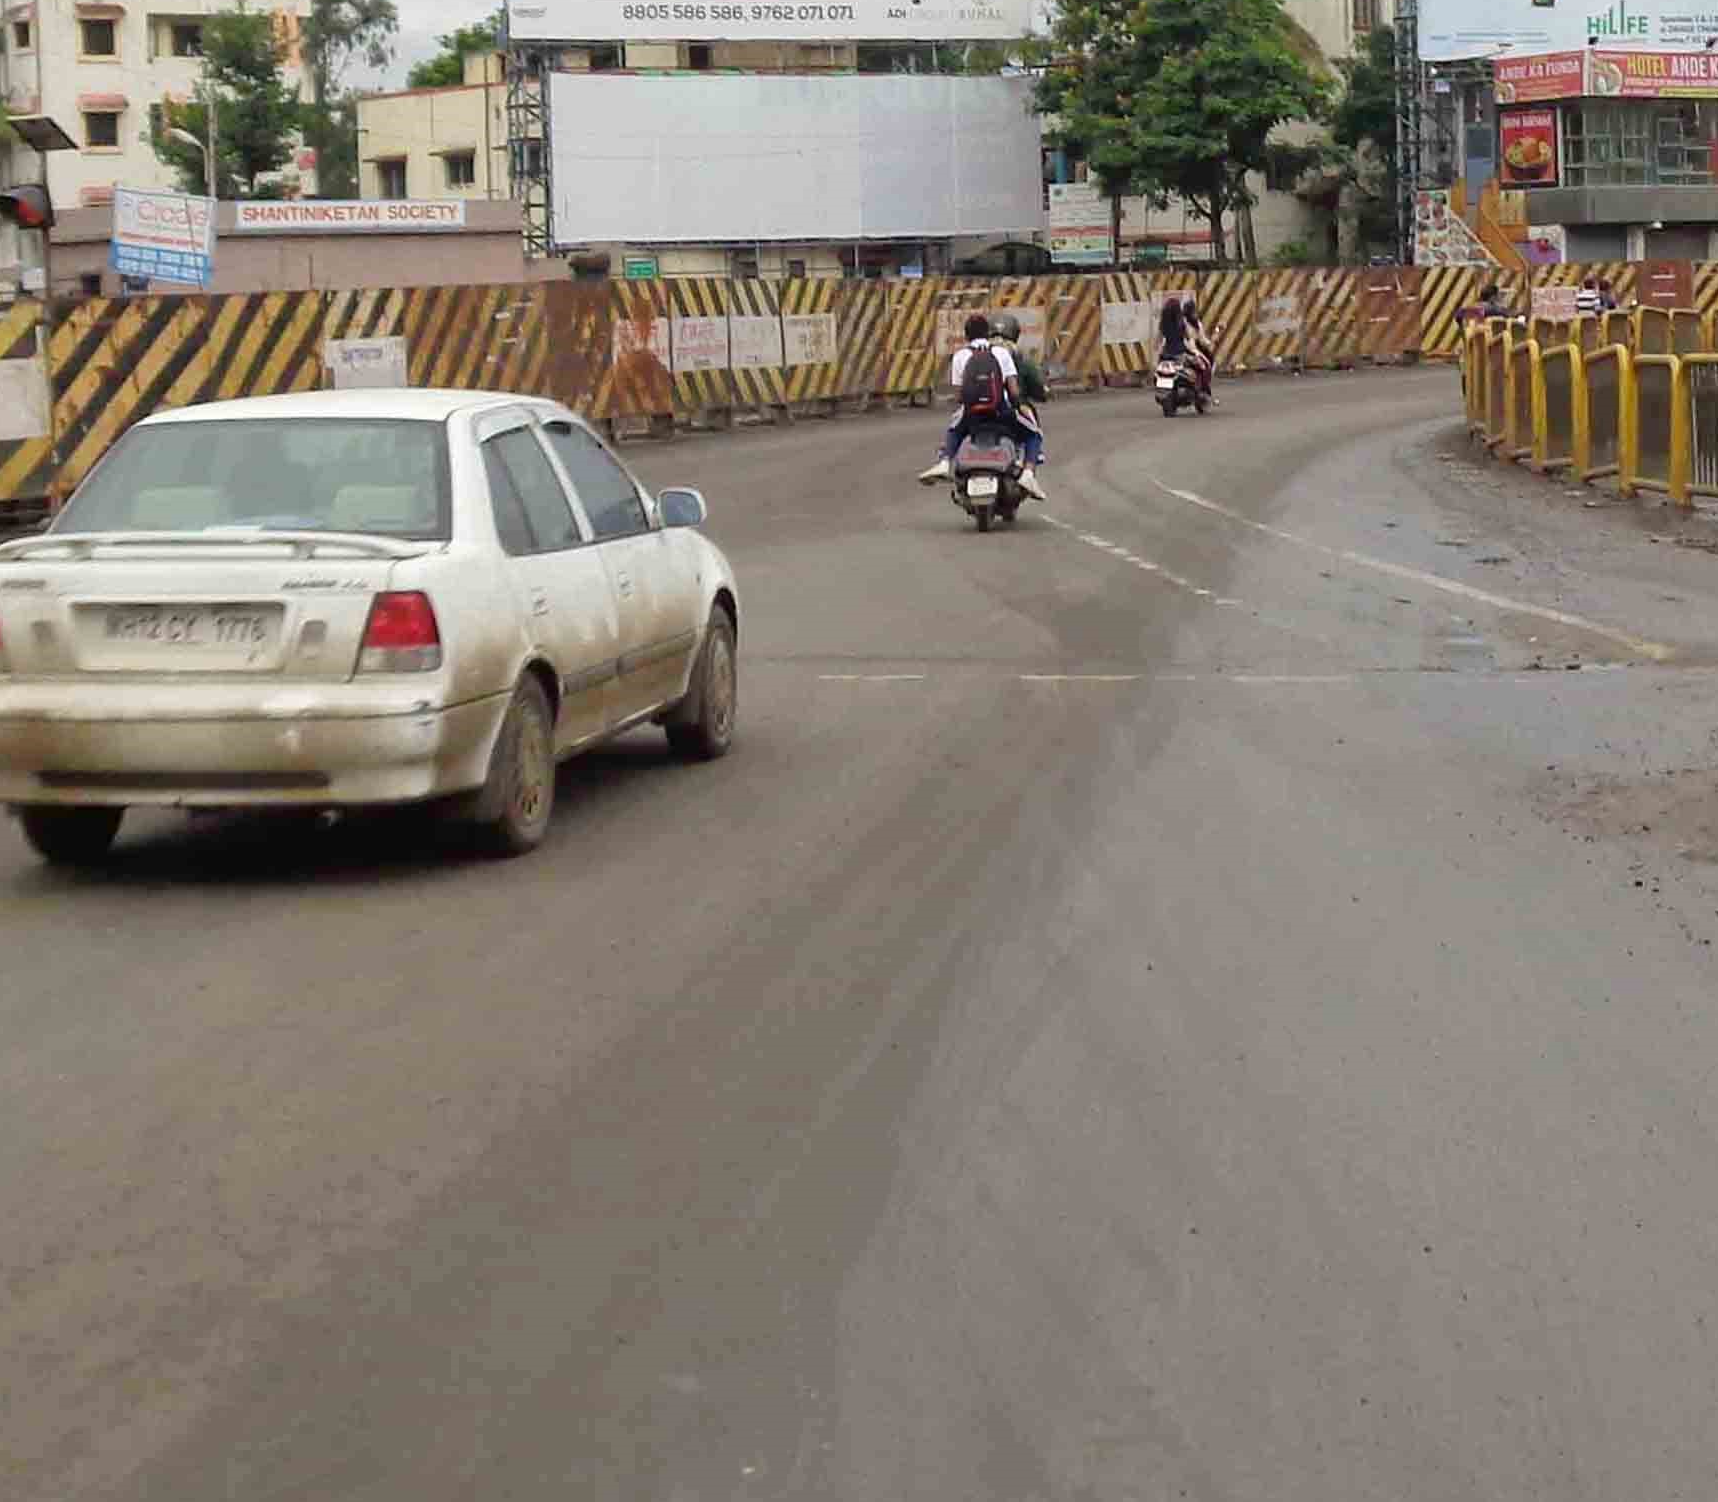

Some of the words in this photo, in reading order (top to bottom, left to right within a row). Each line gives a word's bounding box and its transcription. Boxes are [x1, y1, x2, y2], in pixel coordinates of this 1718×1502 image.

[622, 3, 669, 21] 8805
[672, 4, 707, 21] 586
[751, 4, 794, 21] 9762
[797, 4, 824, 21] 071
[827, 4, 855, 20] 071
[1626, 56, 1668, 78] HOTEL
[1670, 56, 1708, 79] ANDE
[242, 205, 379, 222] SHANTINIKETAN
[386, 204, 459, 221] SOCIETY
